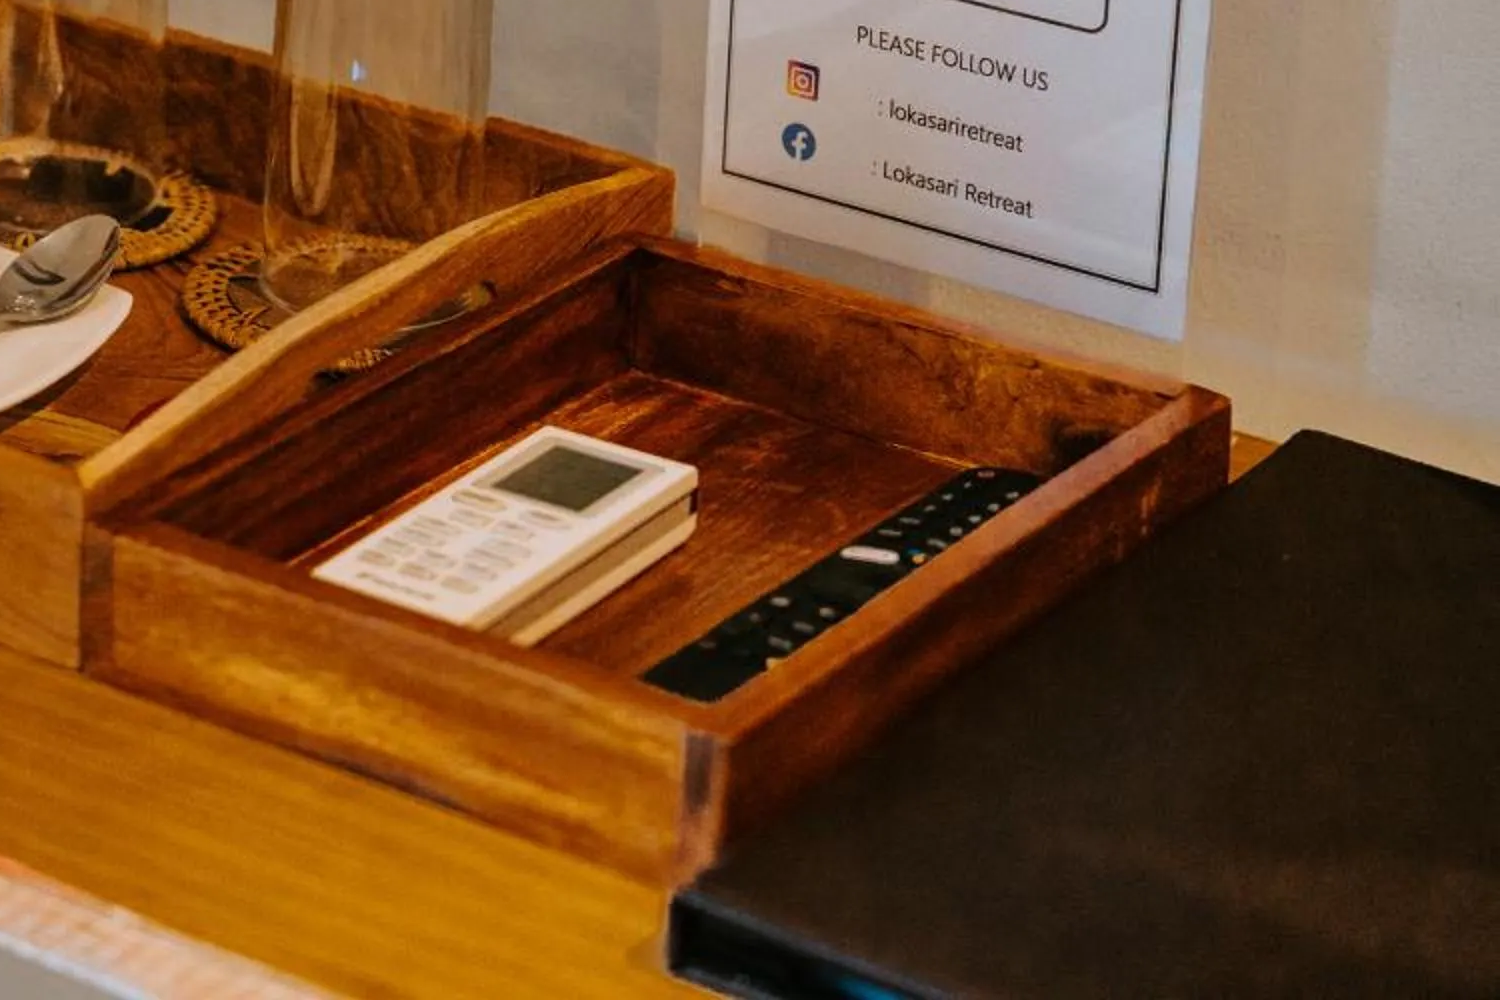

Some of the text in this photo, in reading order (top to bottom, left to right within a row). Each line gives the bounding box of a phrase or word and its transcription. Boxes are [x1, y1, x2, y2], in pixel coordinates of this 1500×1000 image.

[856, 25, 1050, 92] PLEASE FOLLOW US
[889, 99, 1024, 153] lokasariretreat
[883, 161, 960, 198] Lokasari
[964, 182, 1034, 219] Retreat
